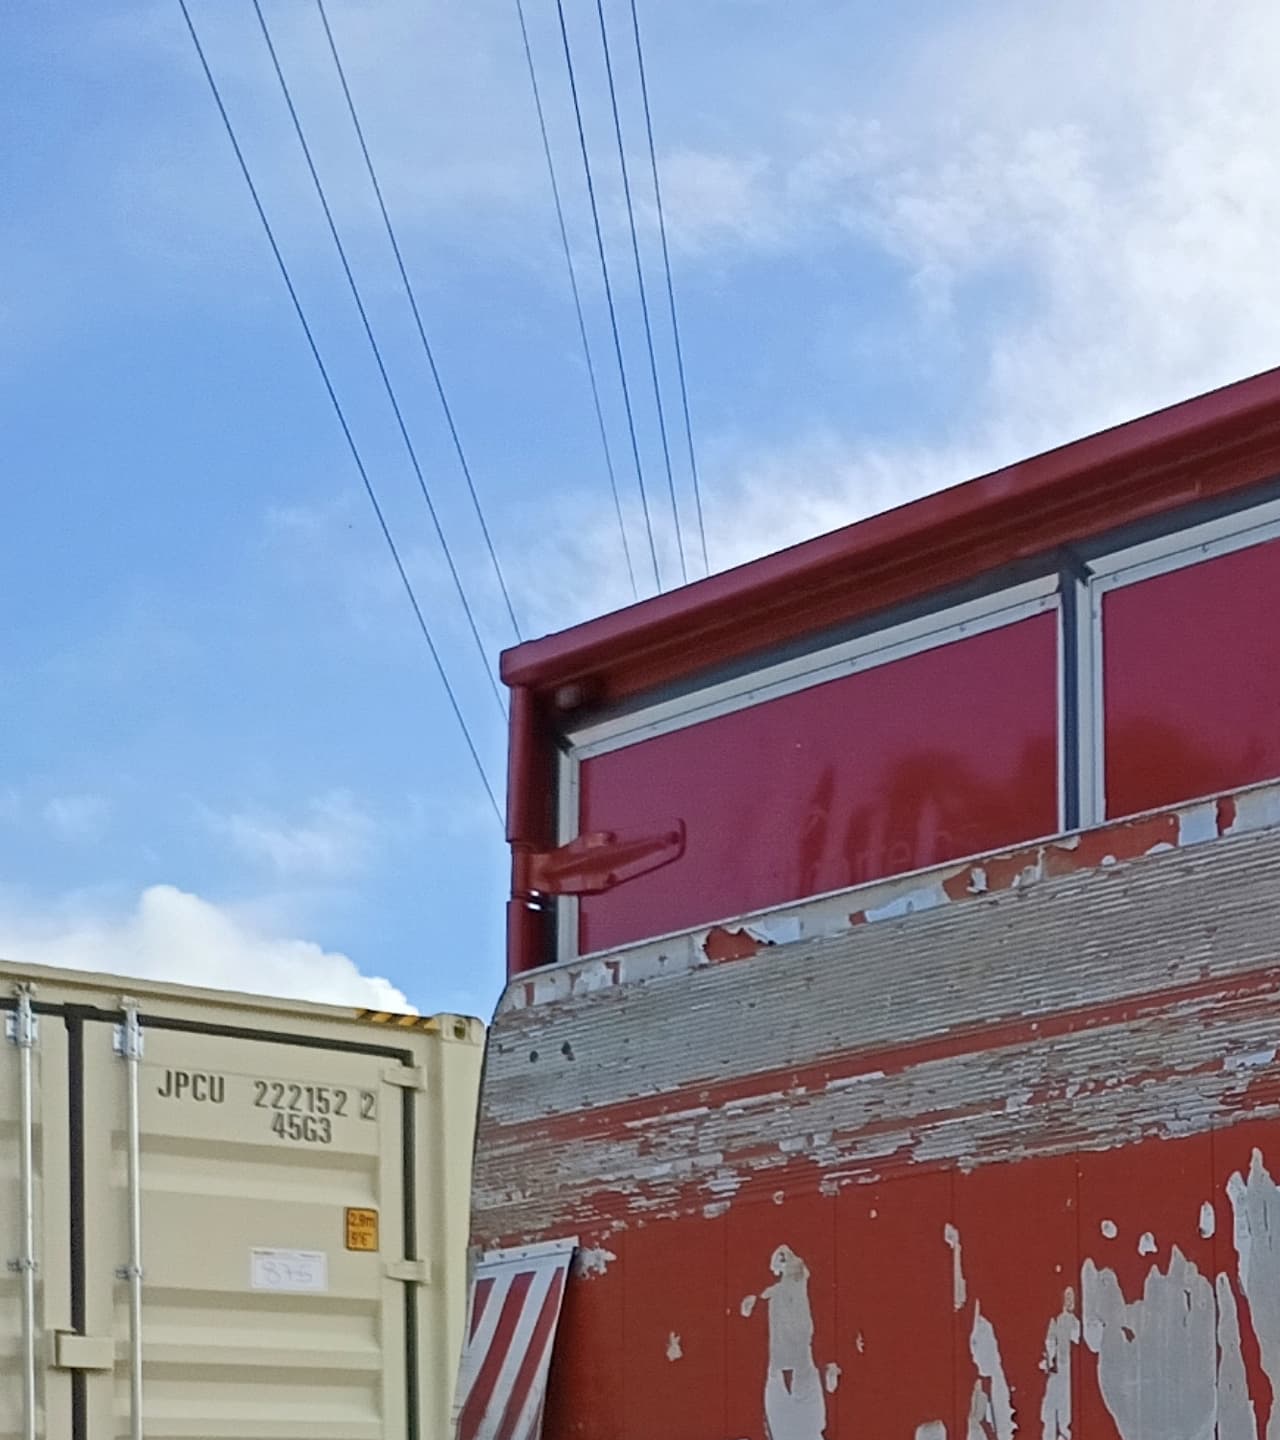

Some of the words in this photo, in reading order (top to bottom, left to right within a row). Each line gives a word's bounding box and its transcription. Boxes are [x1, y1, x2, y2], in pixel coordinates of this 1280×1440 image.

[157, 1069, 225, 1104] JPCU
[253, 1079, 349, 1118] 222152
[271, 1113, 332, 1145] 45G3
